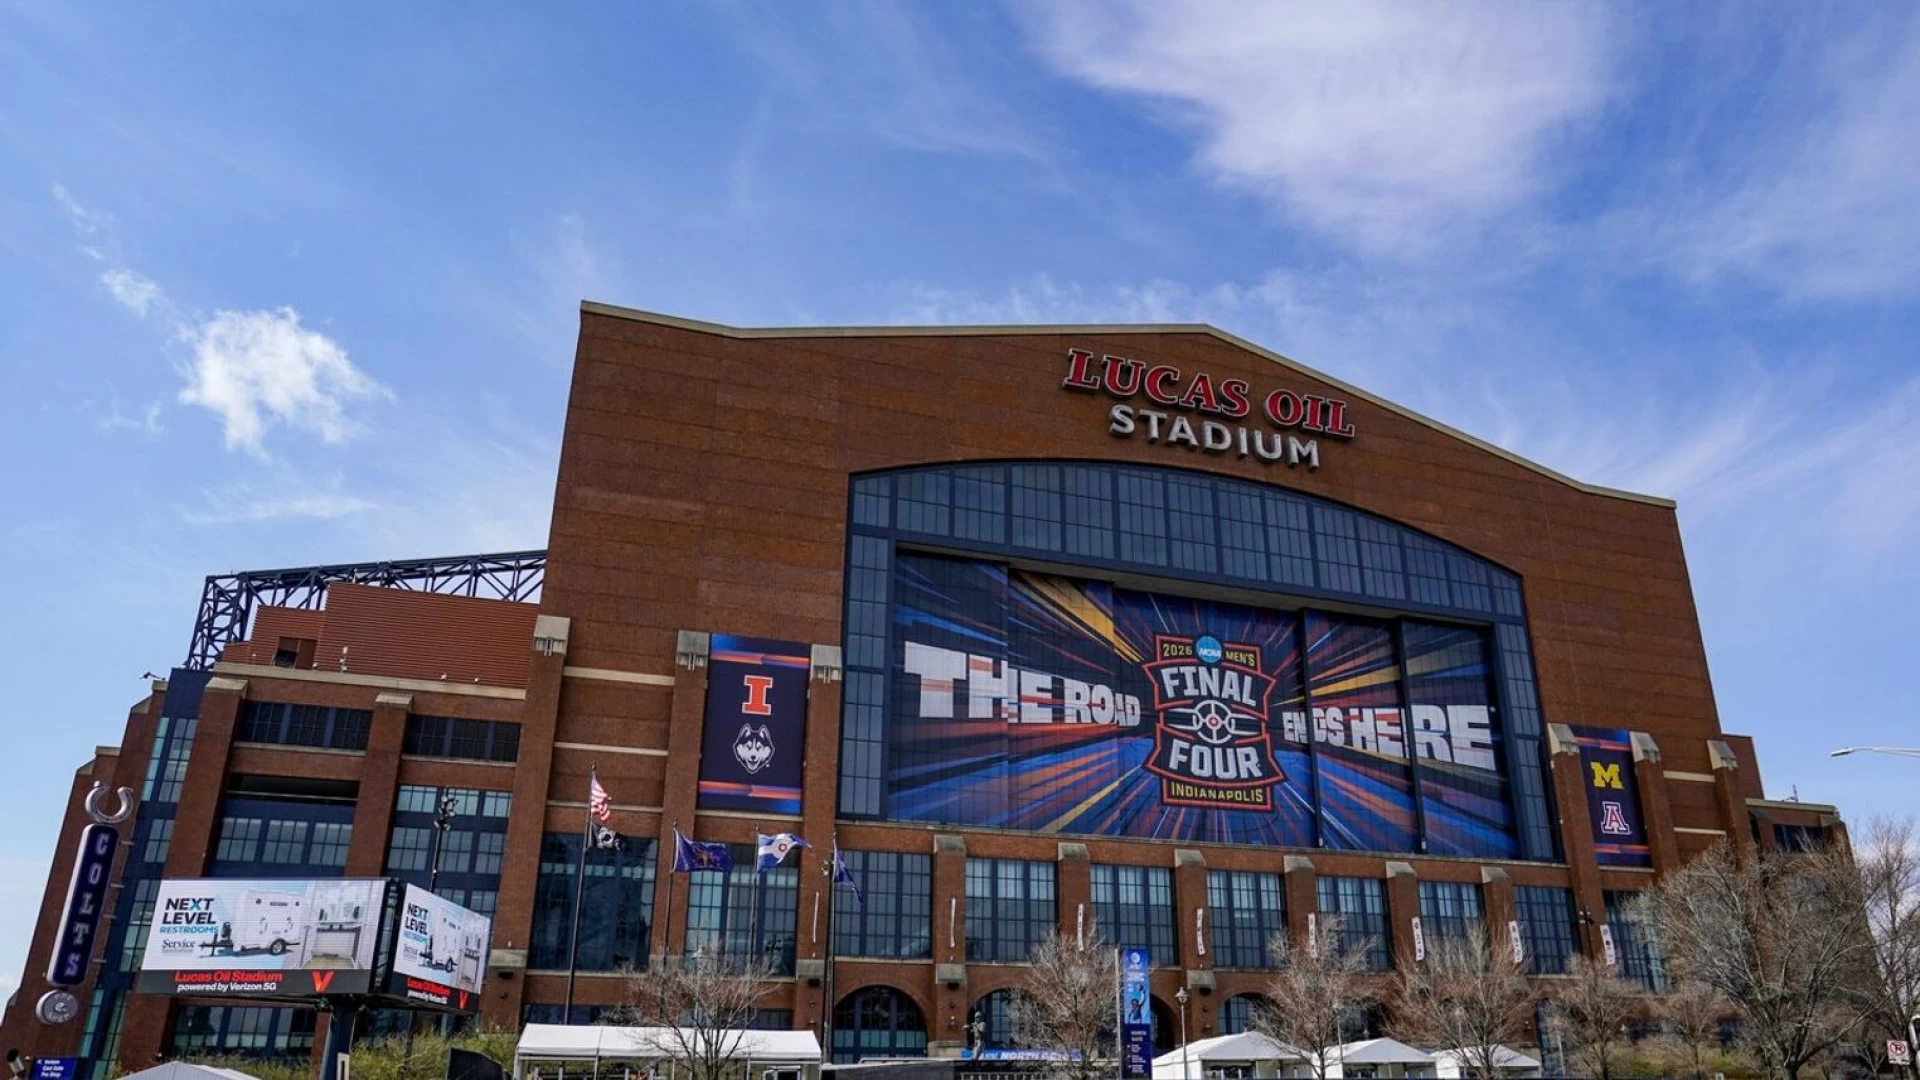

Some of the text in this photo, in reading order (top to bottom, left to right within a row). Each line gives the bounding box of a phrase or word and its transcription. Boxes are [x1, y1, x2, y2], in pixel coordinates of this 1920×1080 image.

[1062, 347, 1356, 438] LUCAS OIL
[1108, 403, 1321, 469] STADIUM
[1163, 643, 1193, 657] 2026
[1225, 651, 1255, 667] MEN'S
[742, 675, 773, 715] I
[1160, 665, 1257, 707] FINAL
[904, 641, 1053, 724] THE
[1064, 677, 1141, 727] ROAD
[1348, 704, 1498, 772] HERE
[1168, 738, 1264, 780] FOUR
[1590, 761, 1624, 789] M
[1171, 782, 1264, 803] INDIANAPOLIS
[1600, 800, 1632, 835] A
[64, 834, 109, 976] COLTS
[166, 898, 213, 910] NEXT
[407, 903, 427, 921] NEXT
[160, 926, 217, 934] RESTROOMS
[162, 912, 217, 925] LEVEL
[404, 916, 428, 936] LEVEL
[162, 938, 196, 949] Service
[174, 971, 212, 982] Lucas
[213, 971, 231, 982] Oil
[231, 971, 283, 982] Stadium
[177, 983, 217, 992] powered
[217, 983, 229, 993] by
[229, 983, 263, 991] Verizon
